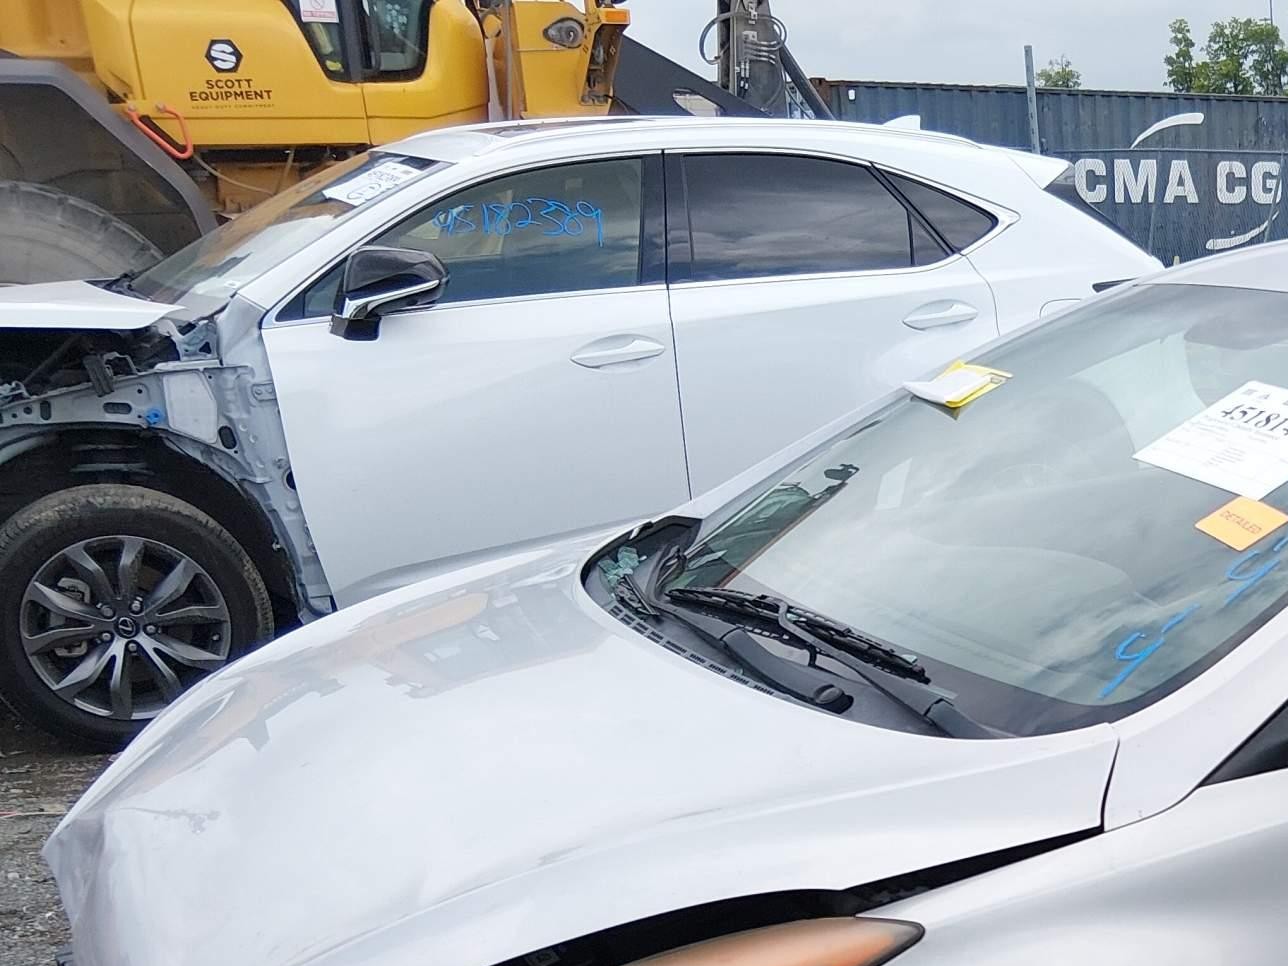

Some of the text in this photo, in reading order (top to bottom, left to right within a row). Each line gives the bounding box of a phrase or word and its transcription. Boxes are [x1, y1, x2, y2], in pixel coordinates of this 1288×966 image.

[205, 78, 253, 90] SCOTT
[189, 89, 273, 102] EQUIPMENT
[1074, 158, 1200, 204] CMA
[1220, 510, 1262, 534] DETAILED
